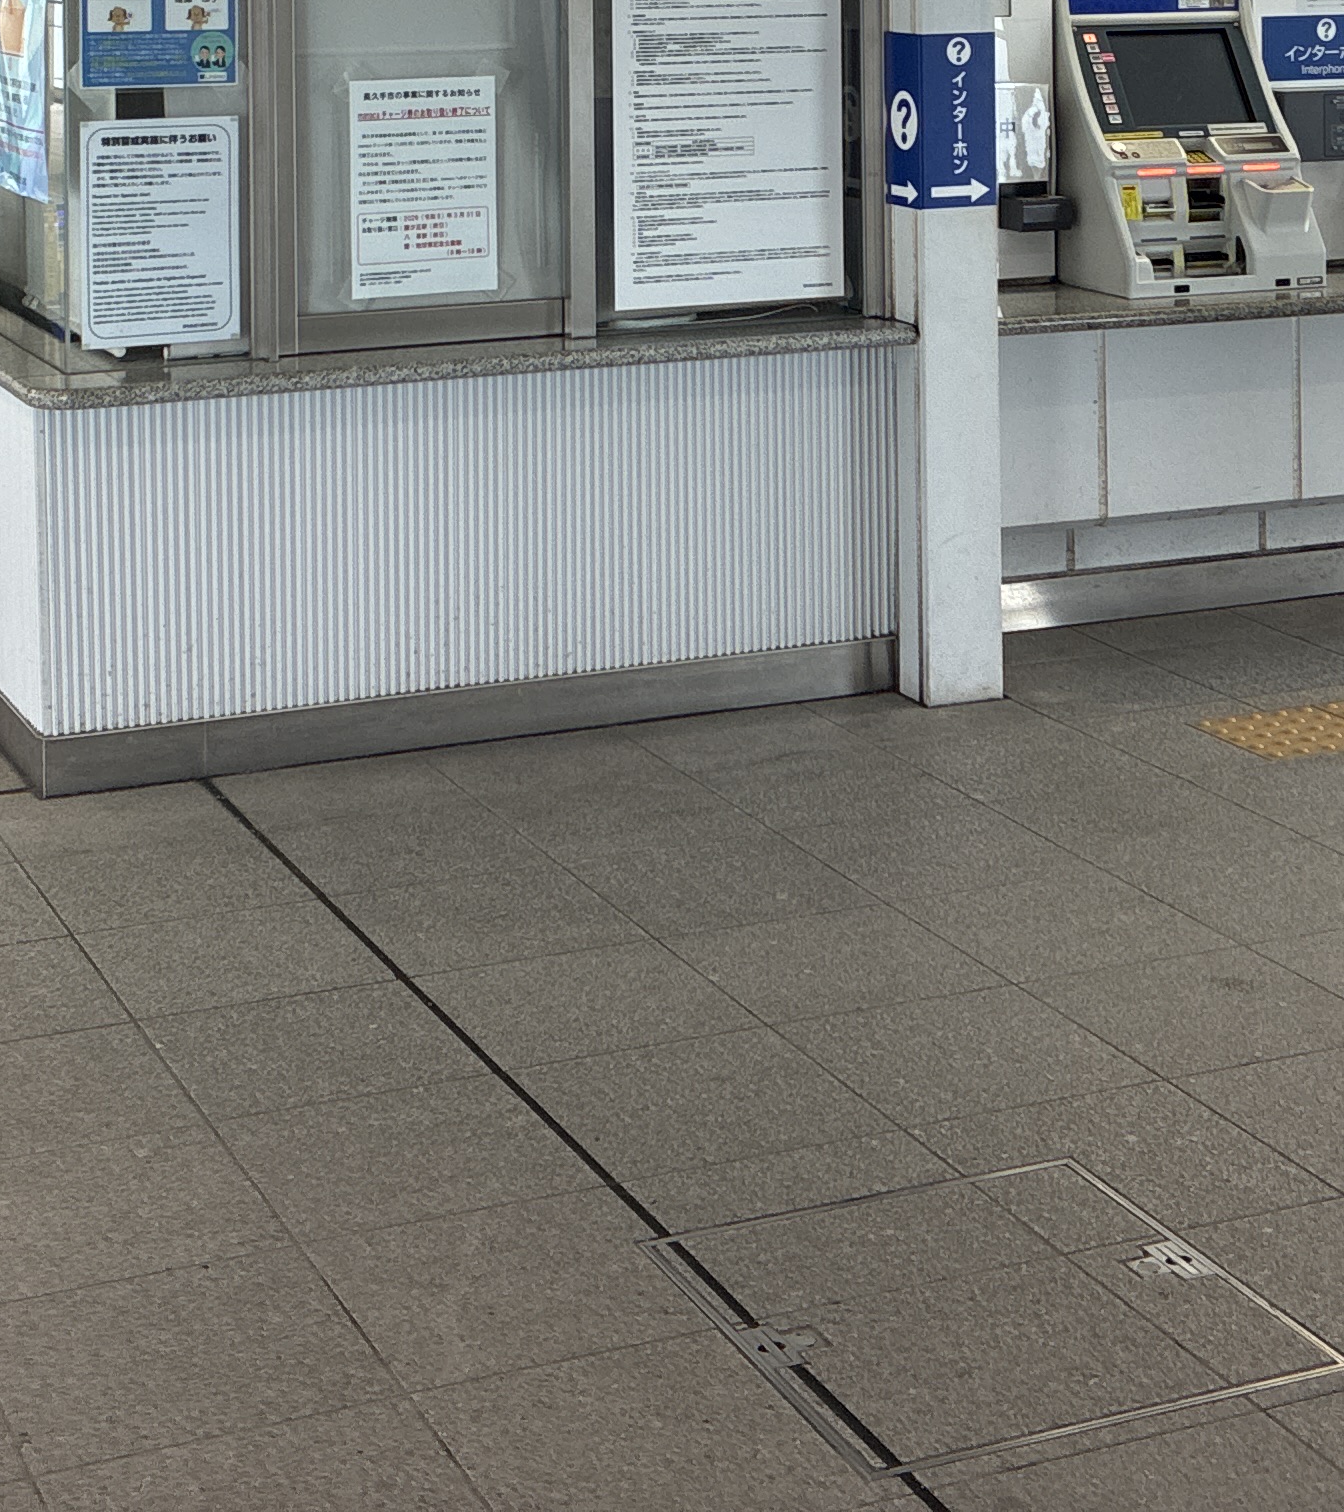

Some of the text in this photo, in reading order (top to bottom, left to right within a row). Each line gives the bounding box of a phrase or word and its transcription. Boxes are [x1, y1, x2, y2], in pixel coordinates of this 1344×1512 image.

[952, 71, 968, 175] インターホン
